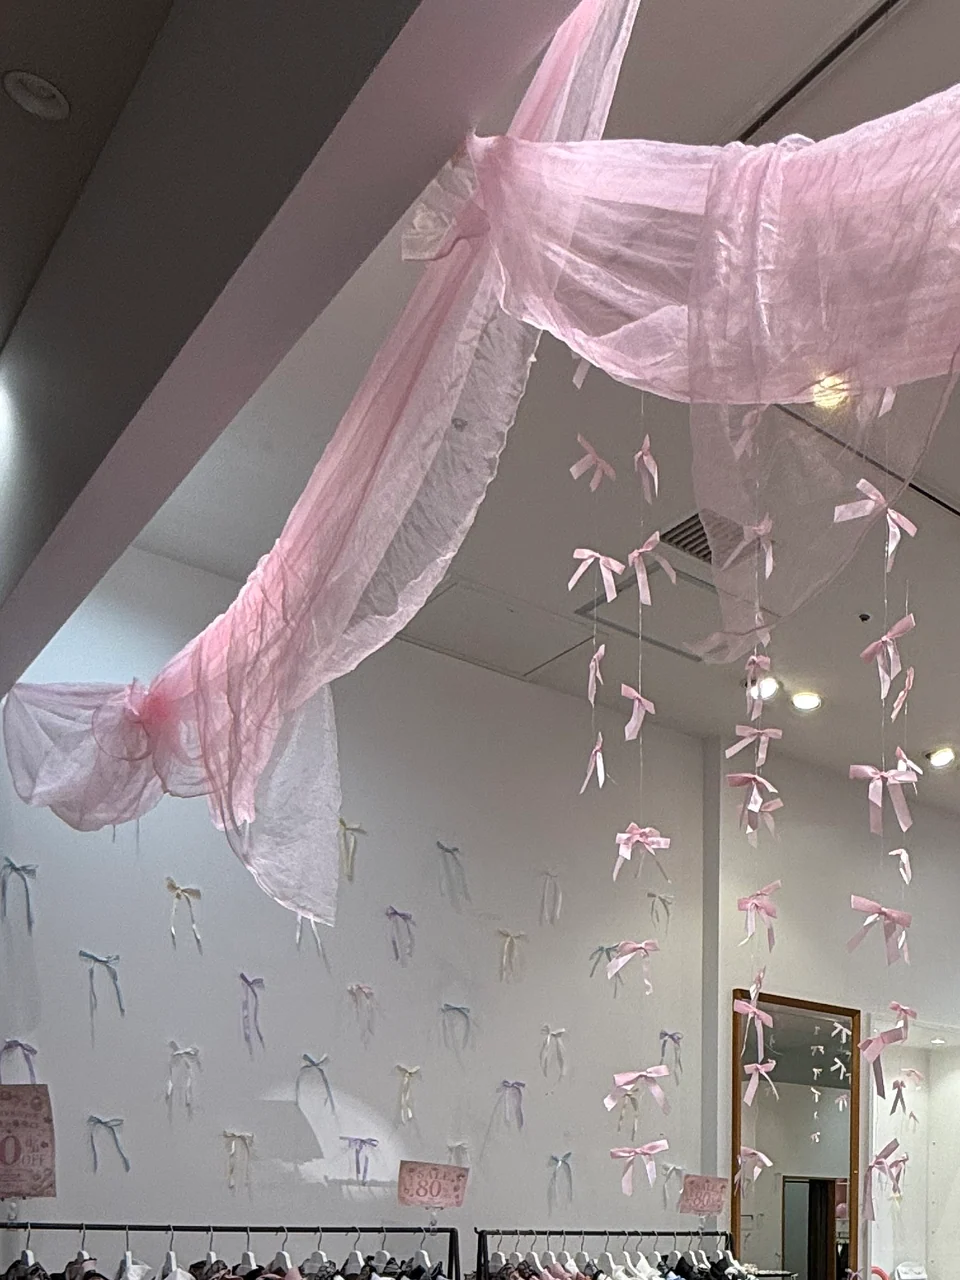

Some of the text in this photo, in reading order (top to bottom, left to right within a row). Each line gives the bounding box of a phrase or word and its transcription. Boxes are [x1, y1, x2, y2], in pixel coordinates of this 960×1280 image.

[21, 1154, 46, 1166] OFF
[417, 1170, 451, 1181] SALE
[415, 1180, 442, 1198] 80
